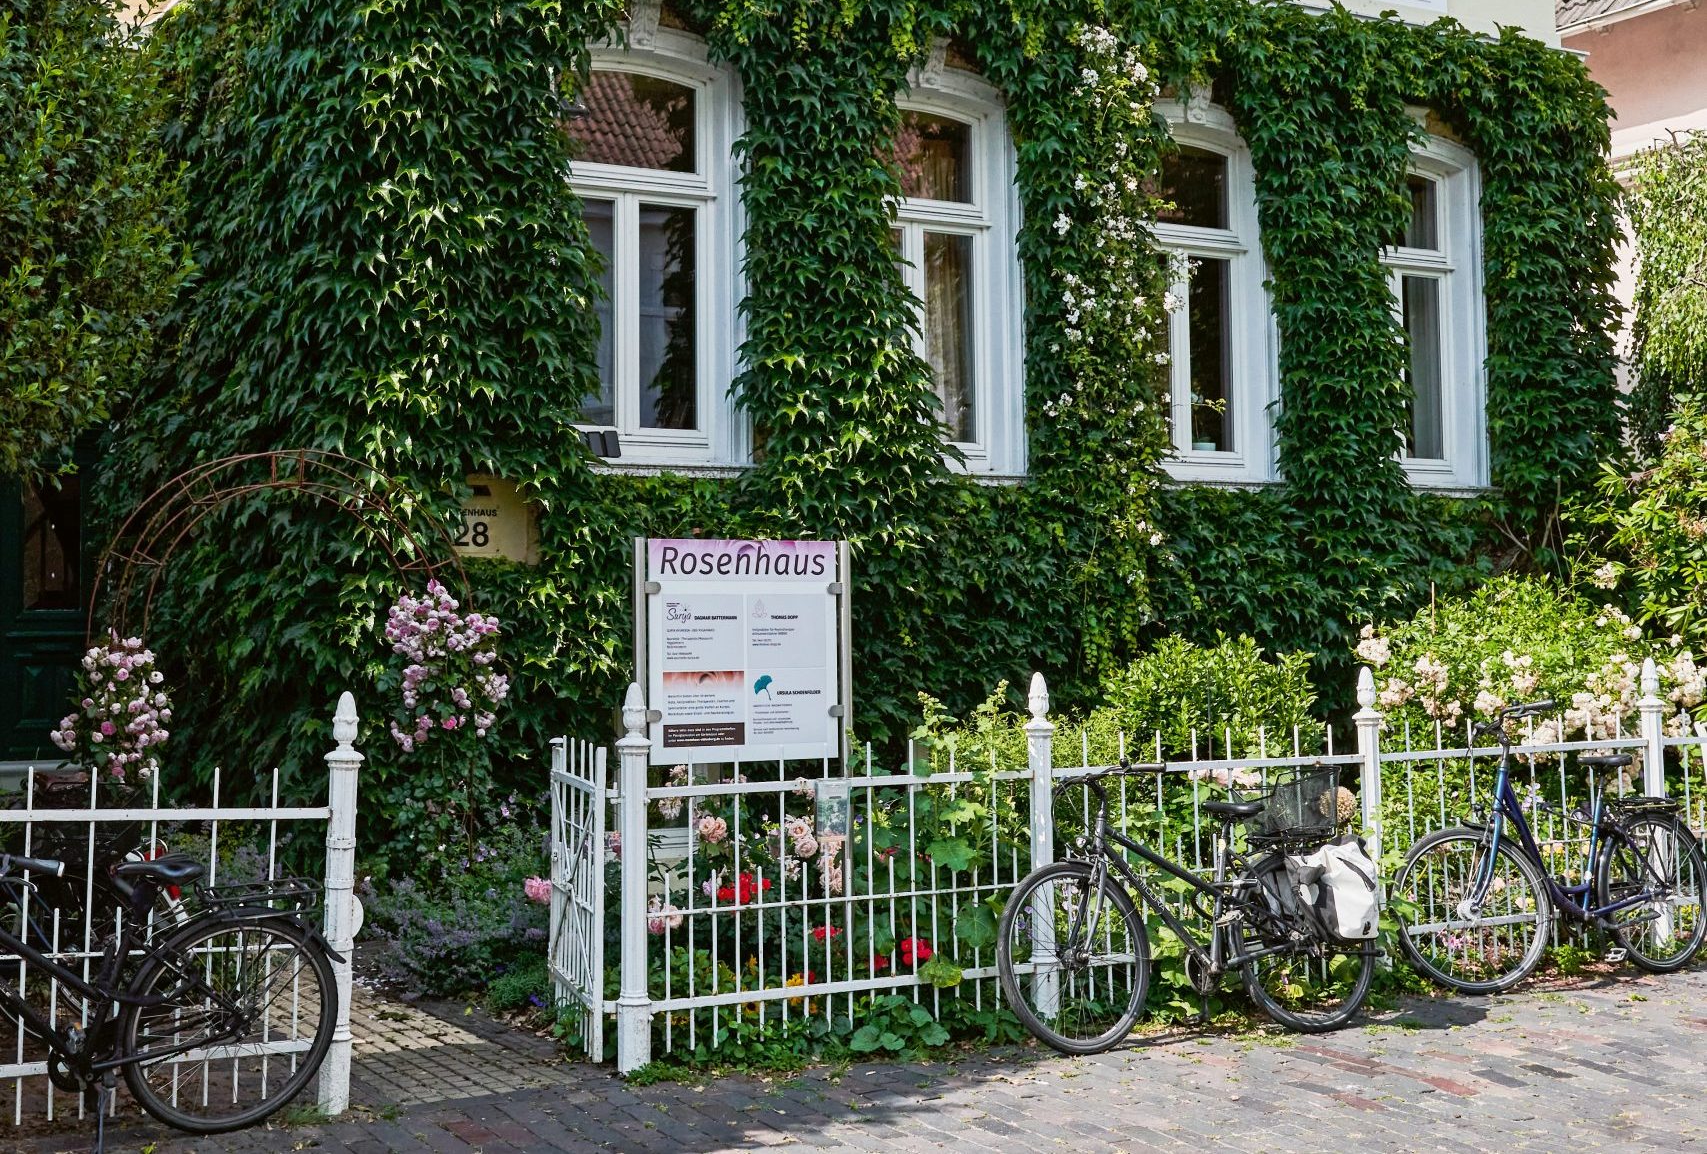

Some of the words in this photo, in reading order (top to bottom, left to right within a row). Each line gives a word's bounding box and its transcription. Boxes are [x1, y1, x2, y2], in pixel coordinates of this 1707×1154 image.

[460, 508, 498, 517] ENHAUS
[452, 521, 489, 547] 28
[660, 545, 826, 576] Rosenhaus
